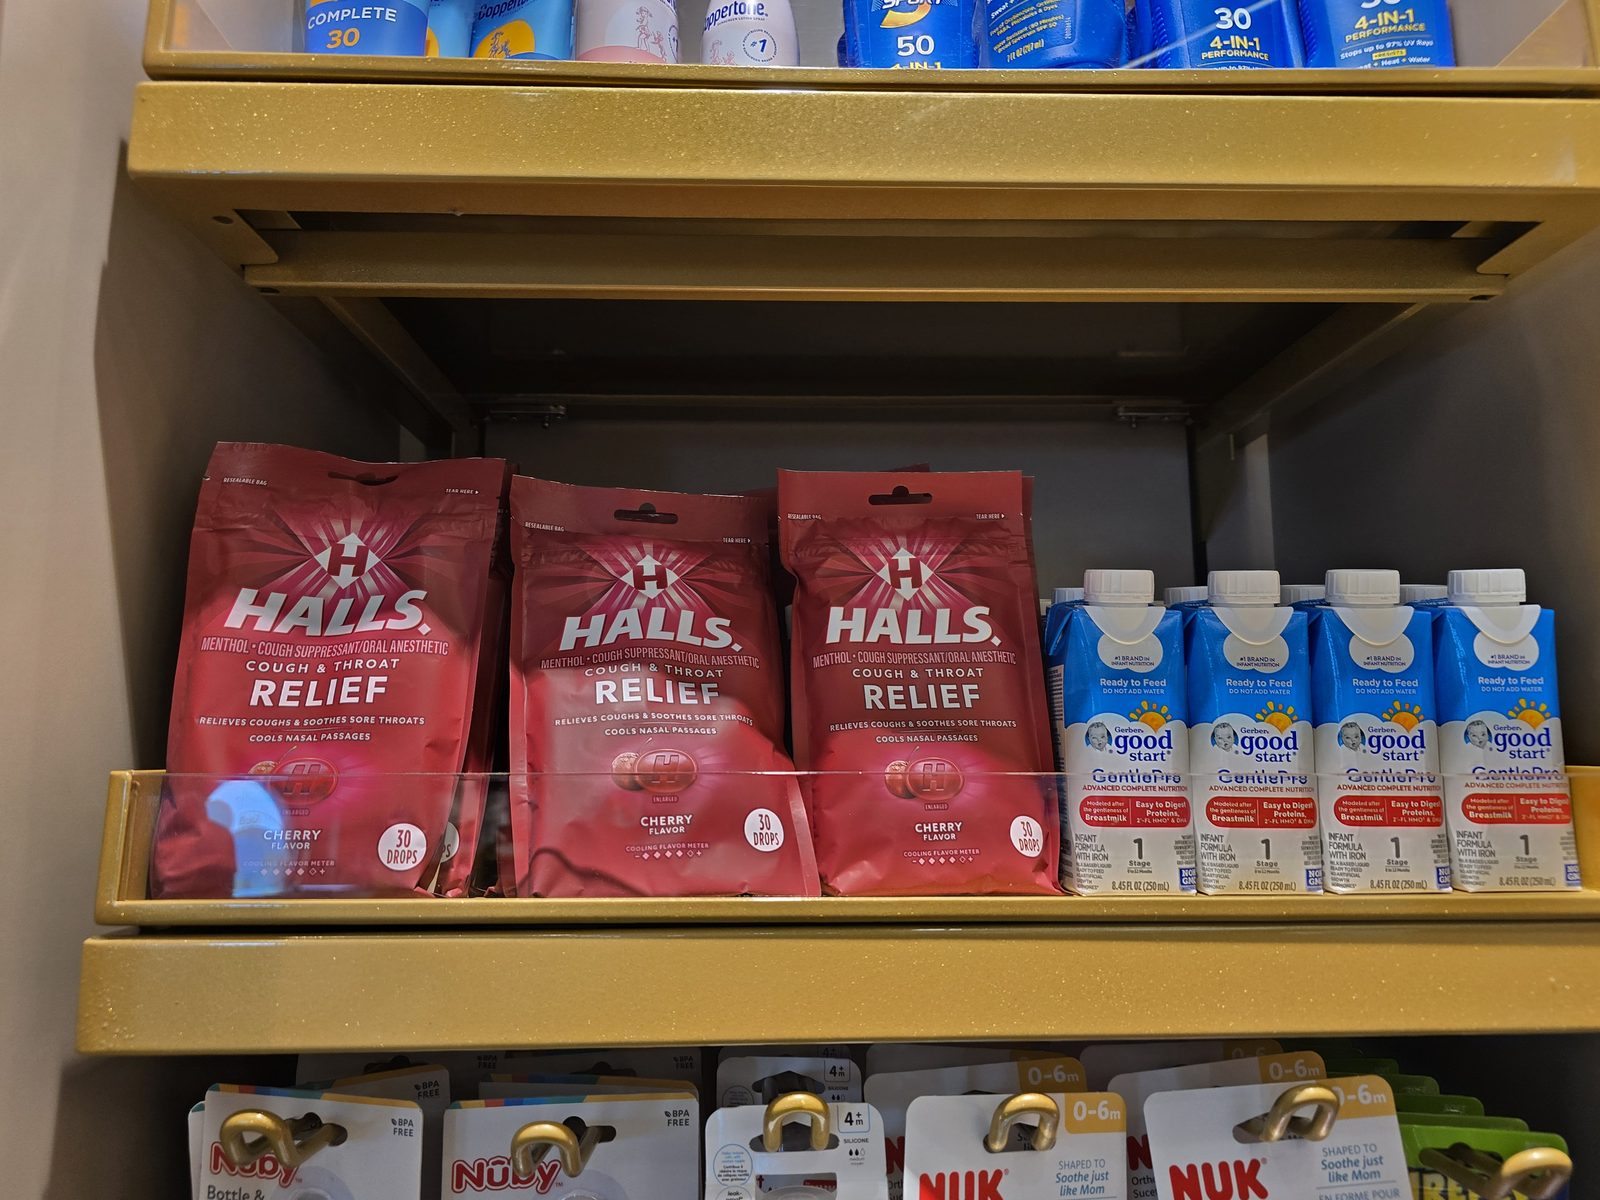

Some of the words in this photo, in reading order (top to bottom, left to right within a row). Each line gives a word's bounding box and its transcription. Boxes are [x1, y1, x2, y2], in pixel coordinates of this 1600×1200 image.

[308, 7, 396, 29] COMPLETE
[1214, 8, 1251, 30] 30
[1355, 8, 1414, 30] 4-IN-1
[326, 28, 360, 48] 30
[1345, 23, 1426, 43] PERFORMANCE
[897, 35, 934, 57] 50
[1210, 35, 1260, 50] 4-IN-1
[1202, 50, 1269, 61] PERFORMANCE
[1340, 49, 1362, 59] Stops
[201, 637, 249, 654] MENTHOL
[258, 641, 293, 658] COUGH
[390, 639, 449, 656] ANESTHETIC
[246, 659, 309, 674] COUGH
[317, 663, 326, 674] &
[334, 658, 399, 672] THROAT
[540, 656, 584, 669] MENTHOL
[592, 651, 623, 664] COUGH
[711, 655, 760, 669] ANESTHETIC
[813, 653, 851, 669] MENTHOL
[857, 652, 886, 664] COUGH
[971, 651, 1016, 665] ANESTHETIC
[584, 663, 641, 677] COUGH
[649, 663, 659, 673] &
[665, 664, 724, 678] THROAT
[852, 668, 903, 679] COUGH
[910, 669, 919, 678] &
[925, 668, 985, 678] THROAT
[1100, 678, 1129, 688] Ready
[1131, 678, 1141, 687] to
[1143, 678, 1166, 687] Feed
[1226, 678, 1254, 689] Ready
[1256, 678, 1267, 687] to
[1269, 678, 1293, 688] Feed
[1352, 678, 1381, 688] Ready
[1383, 678, 1393, 687] to
[1395, 678, 1419, 687] Feed
[1478, 676, 1507, 686] Ready
[1508, 677, 1519, 685] to
[1521, 676, 1544, 685] Feed
[249, 675, 388, 707] RELIEF
[594, 677, 720, 705] RELIEF
[863, 683, 980, 710] RELIEF
[199, 716, 246, 727] RELIEVES
[249, 718, 291, 727] COUGHS
[303, 716, 347, 727] SOOTHES
[350, 715, 375, 725] SORE
[379, 716, 425, 725] THROATS
[554, 715, 598, 726] RELIEVES
[600, 712, 640, 722] COUGHS
[651, 712, 692, 721] SOOTHES
[694, 714, 717, 722] SORE
[719, 714, 753, 726] THROATS
[830, 721, 869, 732] RELIEVES
[871, 720, 906, 729] COUGHS
[916, 719, 955, 728] SOOTHES
[957, 719, 978, 727] SORE
[980, 719, 1017, 728] THROATS
[249, 734, 283, 743] COOLS
[285, 734, 318, 743] NASAL
[320, 732, 371, 743] PASSAGES
[604, 728, 636, 736] COOLS
[639, 727, 670, 735] NASAL
[672, 727, 717, 735] PASSAGES
[876, 734, 905, 743] COOLS
[906, 734, 936, 743] NASAL
[937, 733, 978, 743] PASSAGES
[1114, 730, 1173, 755] good
[1240, 731, 1298, 755] good
[1368, 729, 1425, 754] good
[1494, 727, 1552, 752] good
[1129, 752, 1166, 762] start
[1255, 752, 1291, 763] start
[1383, 751, 1419, 761] start
[1509, 749, 1546, 759] start
[1135, 801, 1153, 809] Easy
[640, 814, 693, 827] CHERRY
[759, 814, 771, 831] 30
[1085, 814, 1127, 822] Breastmilk
[1212, 815, 1254, 823] Breastmilk
[649, 826, 686, 835] FLAVOR
[915, 822, 963, 833] CHERRY
[1020, 822, 1033, 837] 30
[263, 829, 321, 841] CHERRY
[395, 829, 411, 848] 30
[753, 831, 780, 846] DROPS
[923, 833, 956, 841] FLAVOR
[271, 842, 310, 850] FLAVOR
[625, 844, 657, 852] COOLING
[1019, 838, 1040, 852] DROPS
[1133, 838, 1143, 860] 1
[1261, 838, 1271, 860] 1
[387, 849, 417, 864] DROPS
[672, 1109, 689, 1118] BPA
[1073, 1100, 1121, 1121] 0-6m
[398, 1118, 414, 1127] BPA
[667, 1118, 689, 1127] FREE
[393, 1128, 414, 1137] FREE
[1322, 1145, 1361, 1157] SHAPED
[1363, 1143, 1378, 1154] TO
[1058, 1160, 1092, 1170] SHAPED
[1094, 1159, 1105, 1168] TO
[1321, 1157, 1360, 1171] Soothe
[1362, 1155, 1384, 1169] just
[1055, 1172, 1089, 1184] Soothe
[1091, 1171, 1109, 1182] just
[1169, 1158, 1269, 1200] NUK
[1328, 1171, 1349, 1183] like
[1351, 1170, 1381, 1182] Mom
[207, 1185, 250, 1200] Bottle
[1059, 1184, 1077, 1196] like
[1080, 1184, 1105, 1194] Mom
